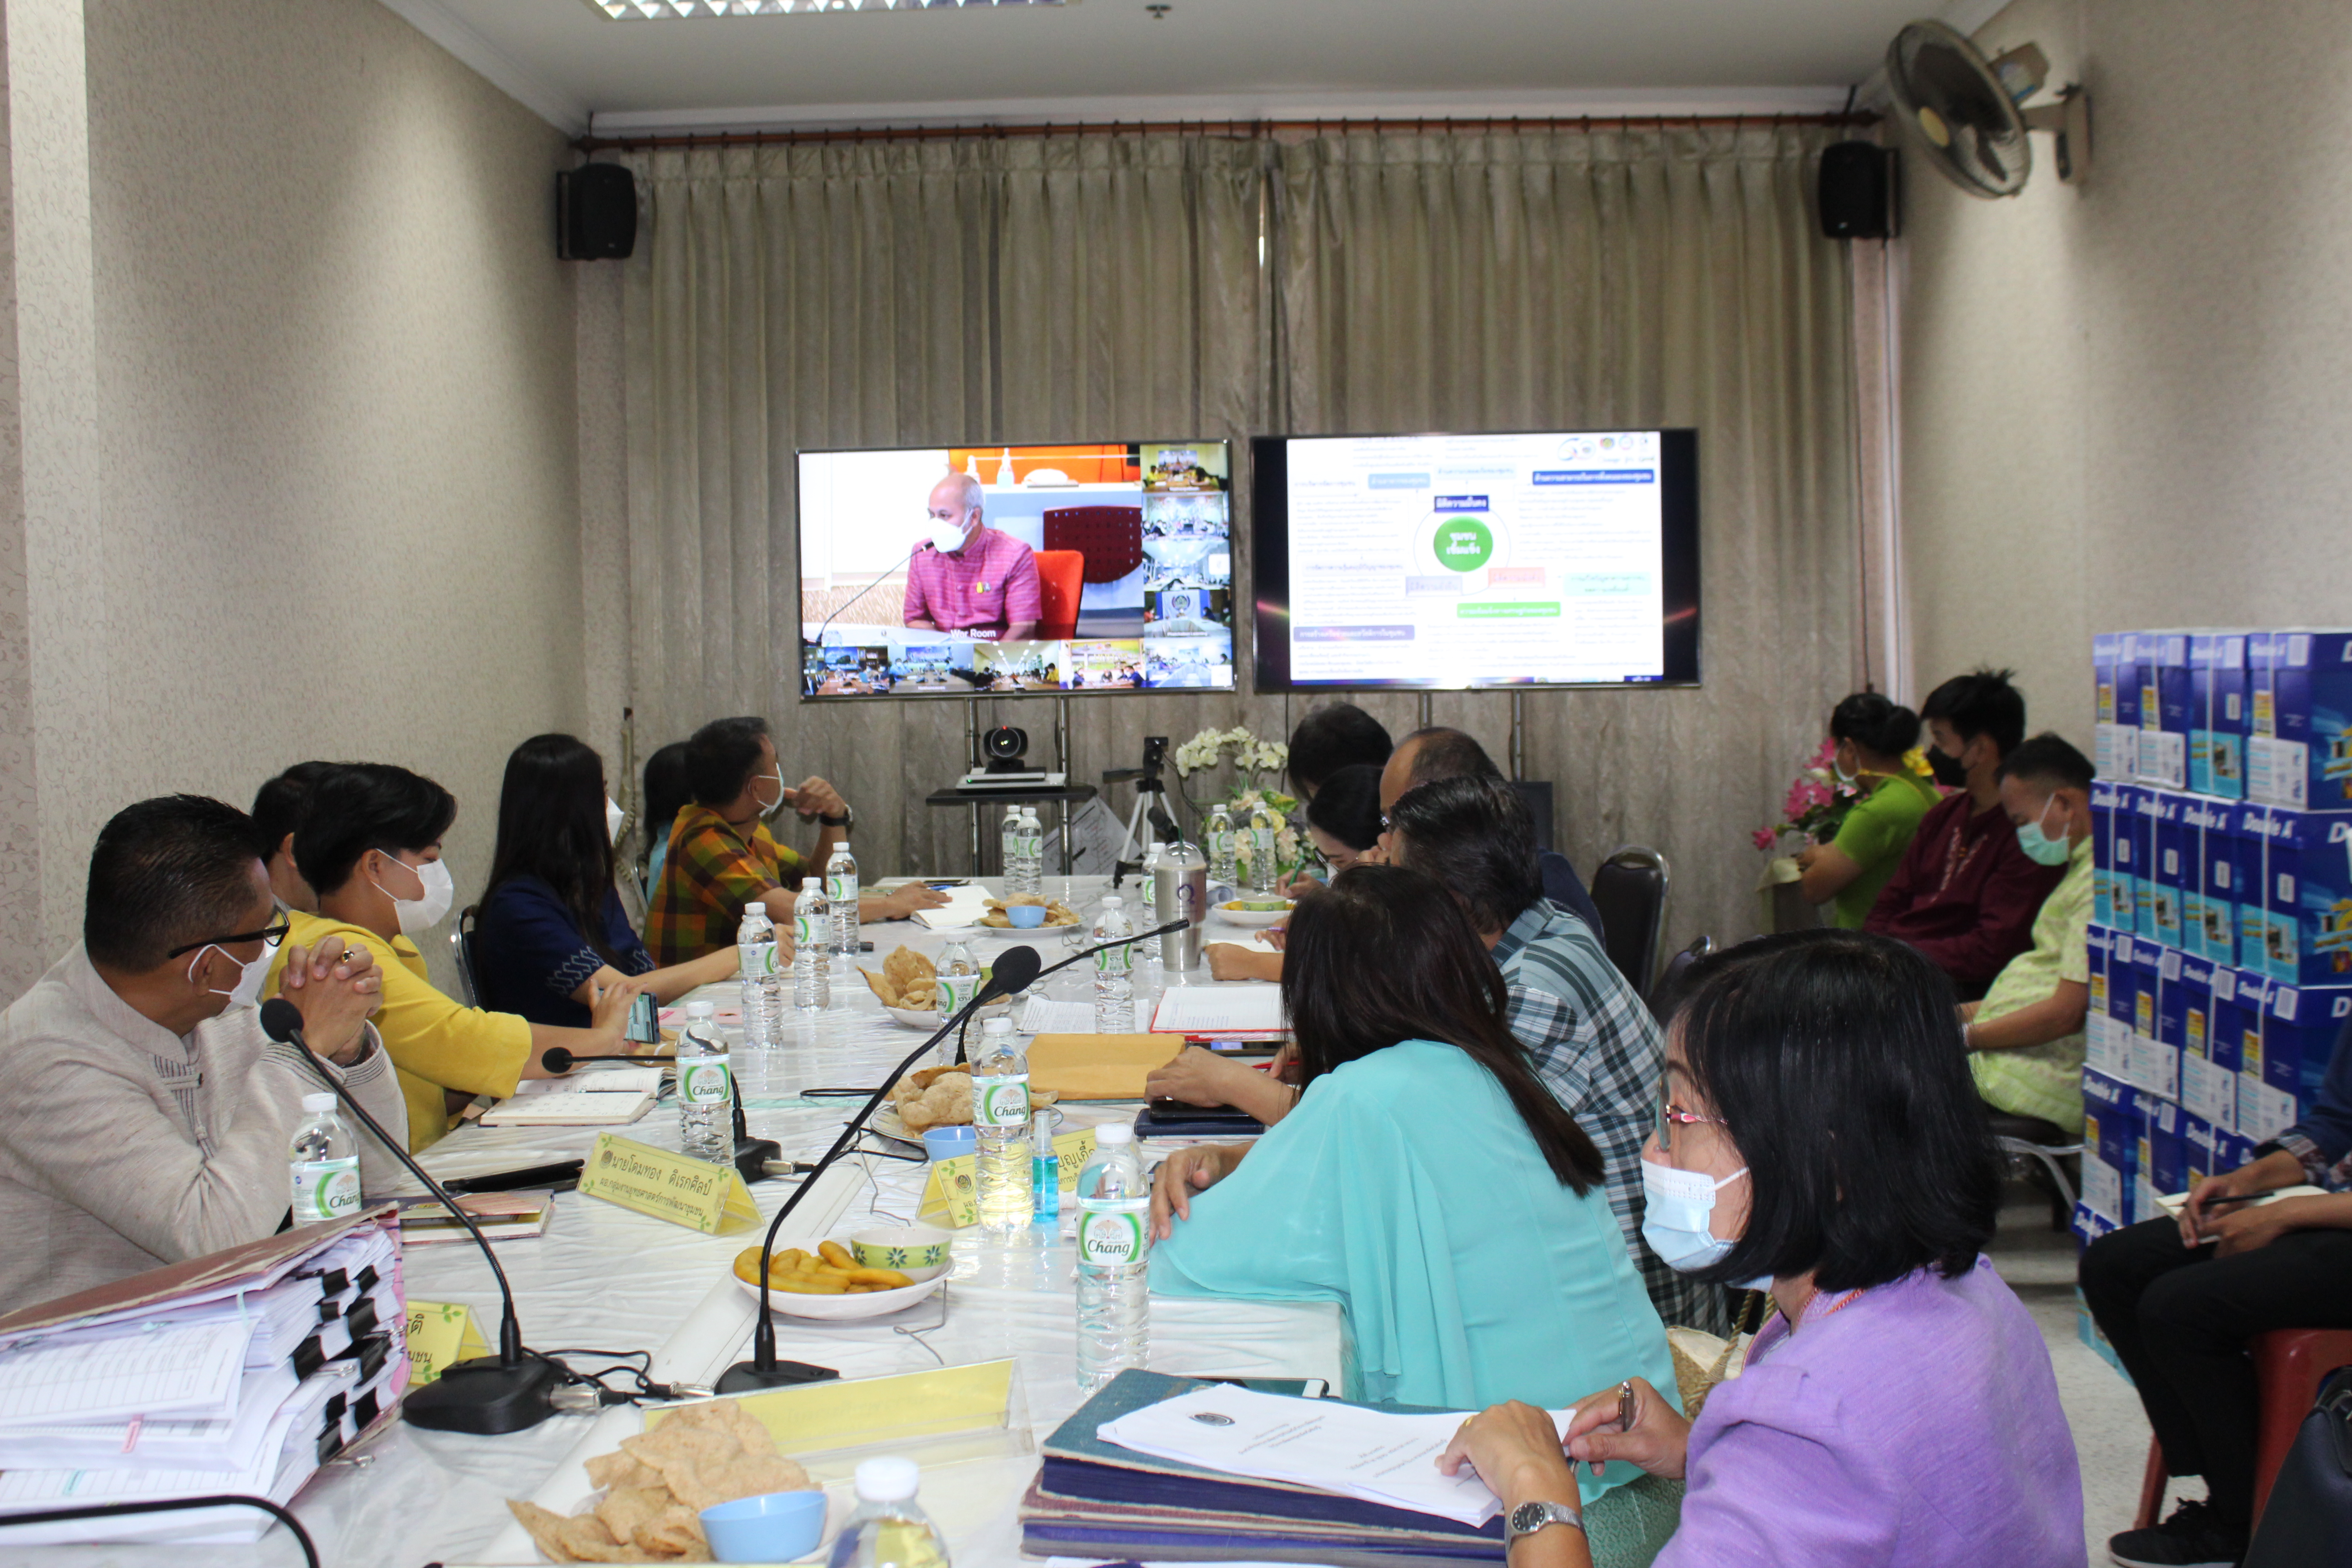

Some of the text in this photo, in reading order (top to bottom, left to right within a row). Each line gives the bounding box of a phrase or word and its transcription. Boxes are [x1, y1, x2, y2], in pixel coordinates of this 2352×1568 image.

[950, 628, 996, 638] War Room
[2091, 789, 2120, 808] Doube
[2137, 796, 2166, 818] Doule
[2183, 806, 2216, 828] Doule
[2243, 812, 2281, 836] Doule
[2238, 981, 2265, 1003] Doubl
[692, 1084, 724, 1097] Chang
[995, 1106, 1026, 1117] Chang
[2185, 1122, 2217, 1152] Doube
[611, 1154, 713, 1196] นายโดมทอง ดิเรกศิลป์
[2074, 1211, 2104, 1238] Doule
[1088, 1239, 1131, 1256] Chang
